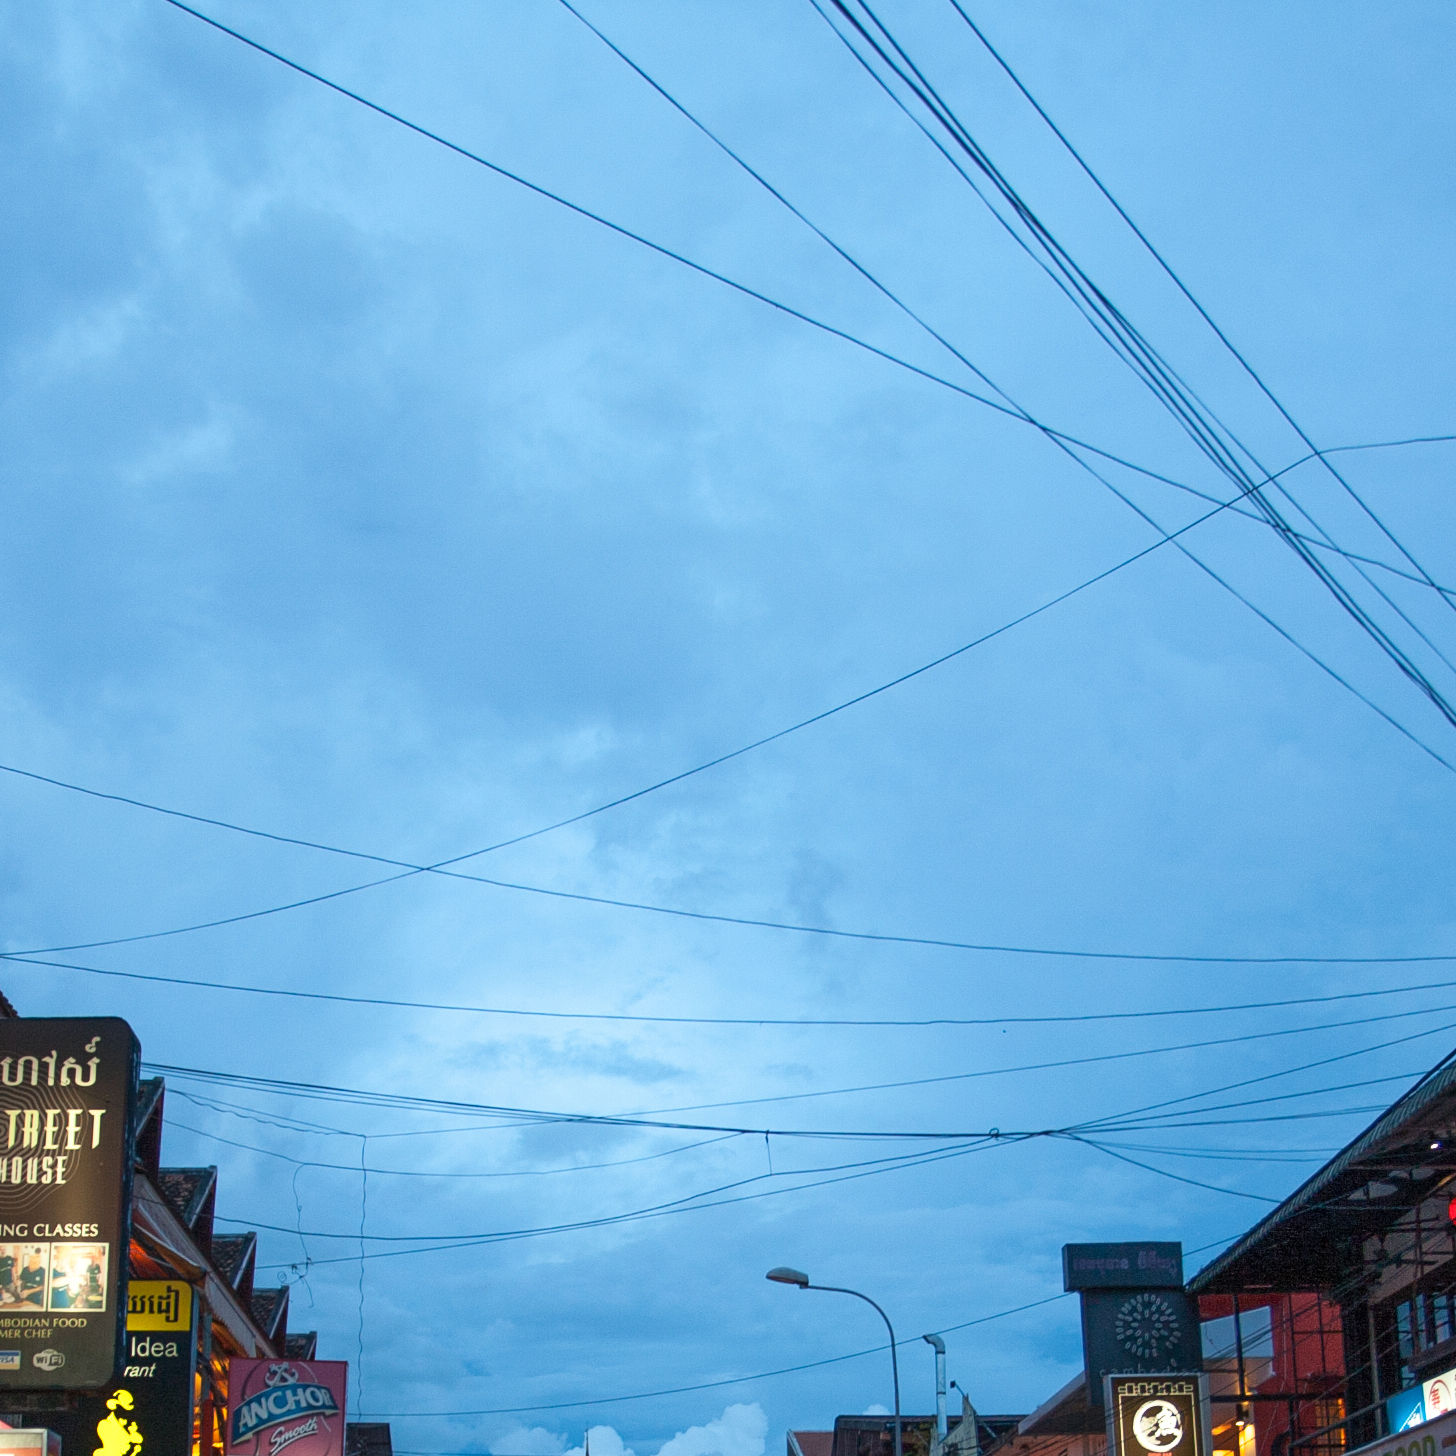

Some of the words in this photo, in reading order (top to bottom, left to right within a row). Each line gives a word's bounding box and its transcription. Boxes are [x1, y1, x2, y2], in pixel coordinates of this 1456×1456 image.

[33, 1223, 99, 1237] CLASSES
[53, 1318, 87, 1328] FOOD
[24, 1329, 54, 1338] CHEF
[131, 1336, 178, 1357] Idea
[238, 1387, 334, 1433] ANCHOR
[269, 1416, 319, 1454] Smooth
